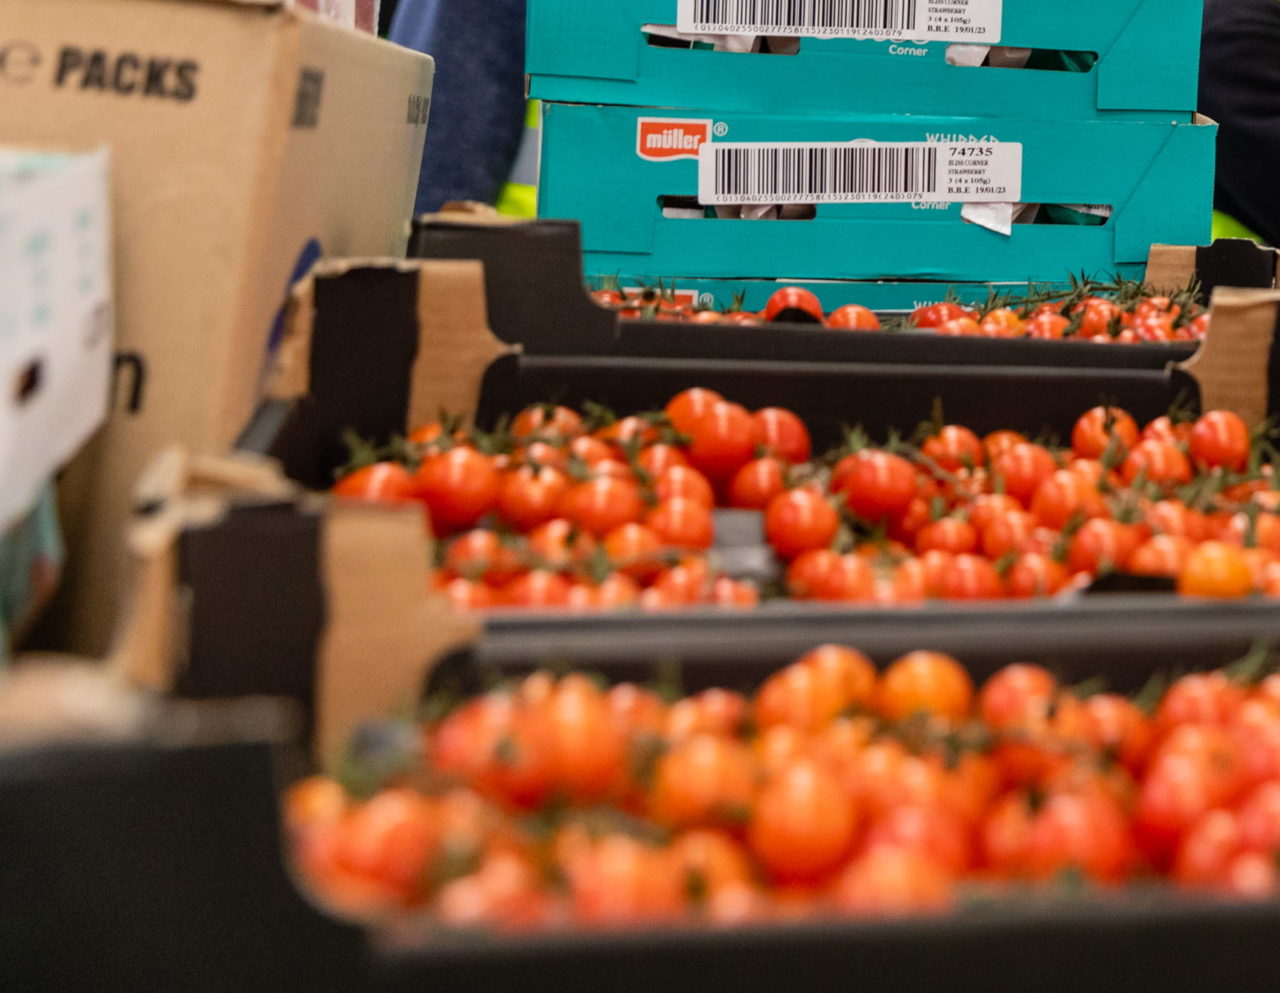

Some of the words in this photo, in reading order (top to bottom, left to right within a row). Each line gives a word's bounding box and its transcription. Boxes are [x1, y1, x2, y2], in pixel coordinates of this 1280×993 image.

[955, 26, 986, 34] 19/01/23
[889, 44, 928, 56] Corner
[54, 43, 200, 104] PACKS
[646, 128, 702, 150] müller
[949, 147, 993, 156] 74735
